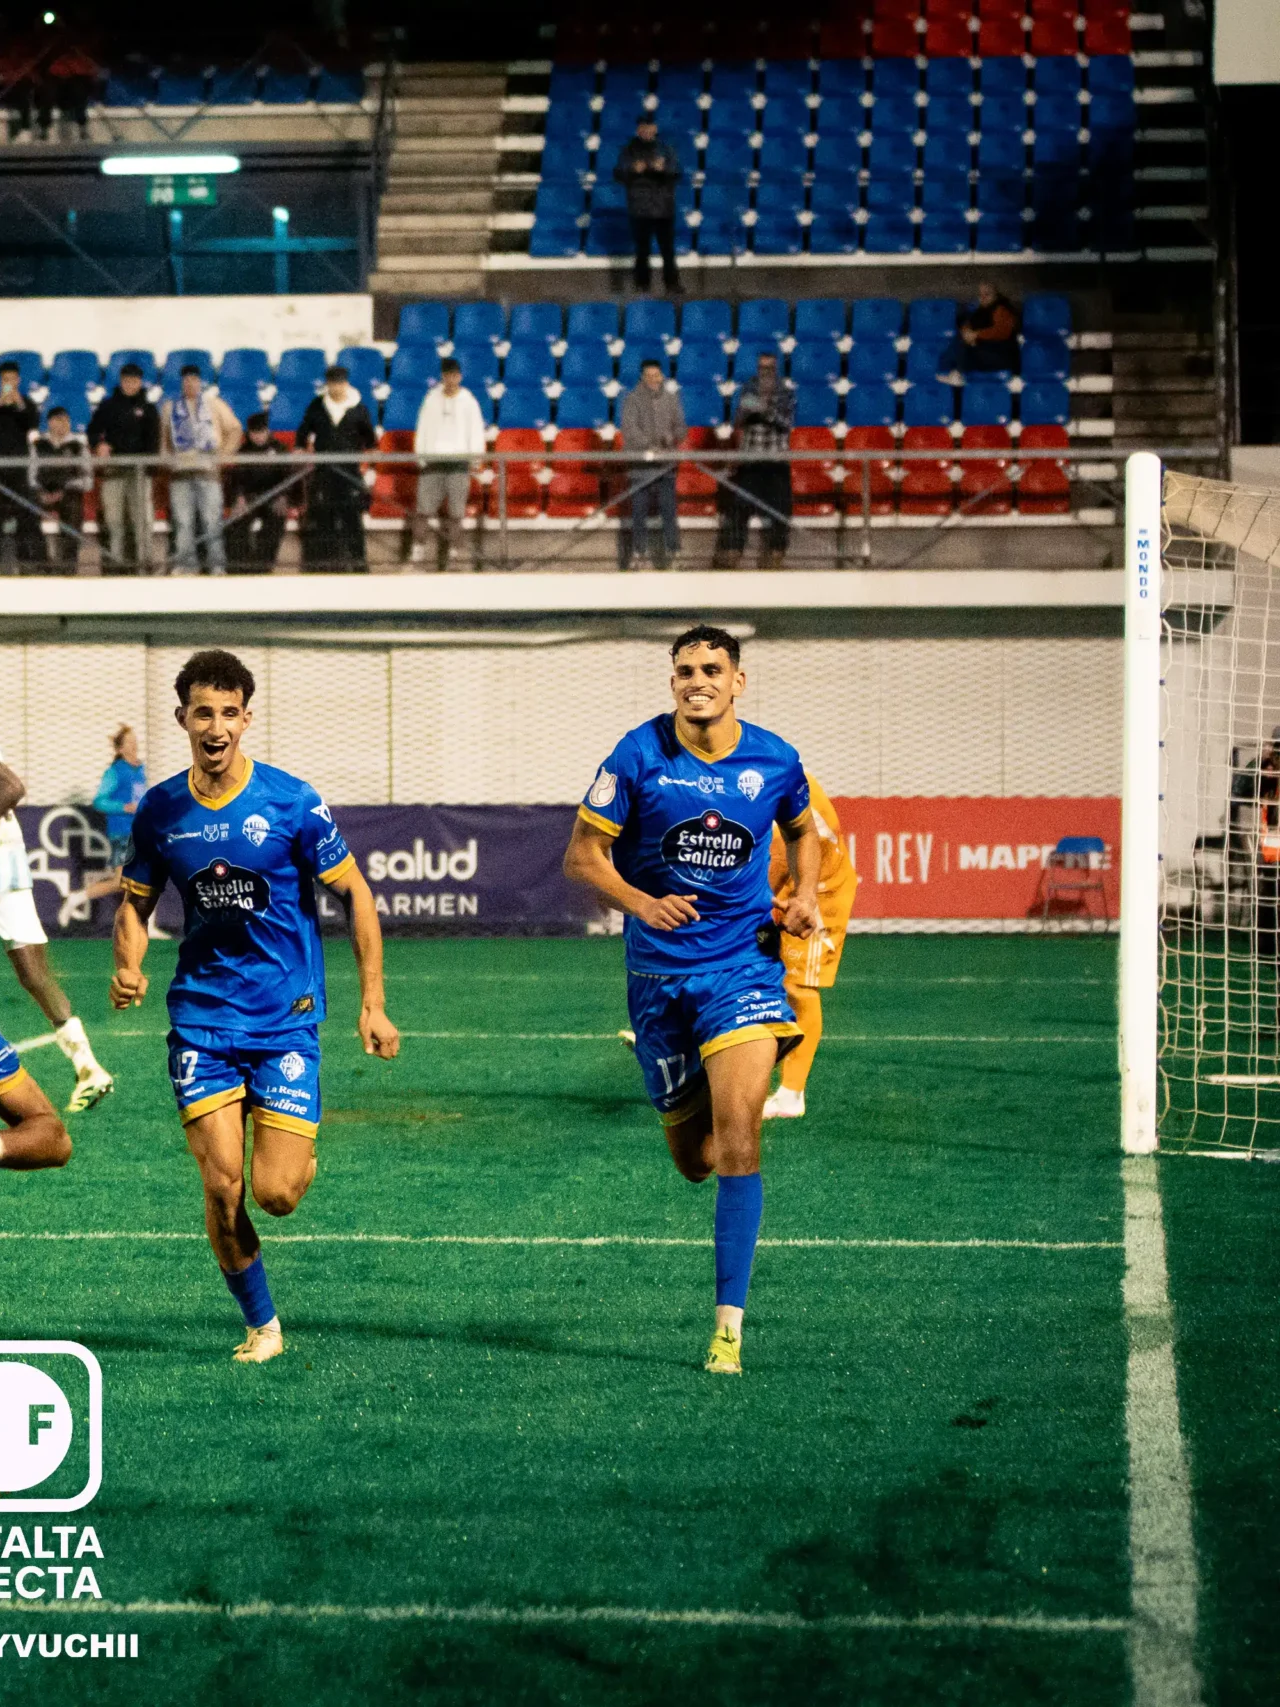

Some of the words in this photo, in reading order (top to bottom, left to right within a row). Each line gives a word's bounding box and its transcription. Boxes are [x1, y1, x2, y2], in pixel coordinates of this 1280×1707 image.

[1136, 539, 1151, 599] MONDO
[677, 829, 743, 850] Estrella
[368, 838, 479, 881] salud
[677, 847, 737, 868] Galicia
[876, 832, 934, 884] REY
[194, 878, 255, 897] Estrella
[375, 893, 479, 916] ARMEN
[263, 1095, 308, 1116] Ontime
